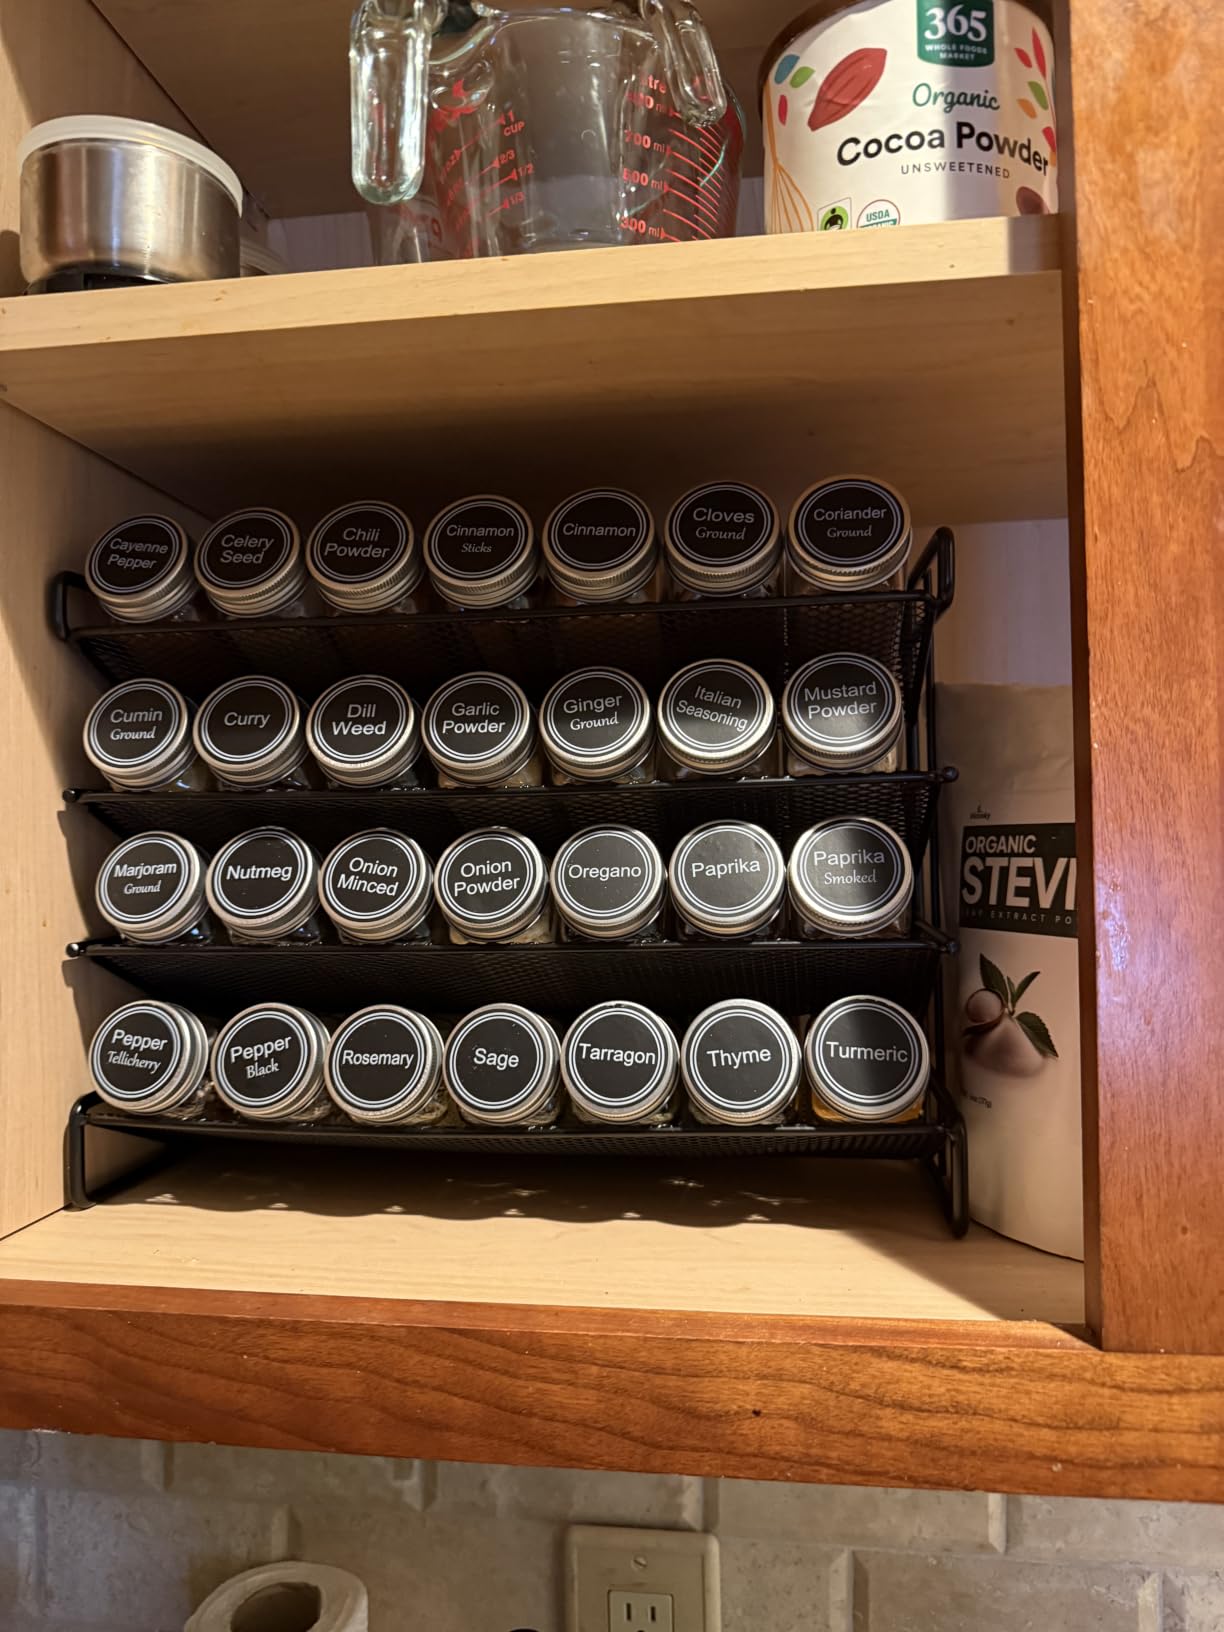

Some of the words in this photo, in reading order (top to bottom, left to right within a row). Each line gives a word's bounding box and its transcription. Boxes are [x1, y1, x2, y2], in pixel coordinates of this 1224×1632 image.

[924, 5, 987, 41] 365
[940, 52, 975, 60] MARKET
[960, 45, 987, 53] FOODS
[912, 83, 1000, 113] Organic
[503, 121, 525, 136] CUP
[837, 129, 945, 166] Cocoa
[956, 122, 1048, 176] Powder
[901, 162, 1010, 179] UNSWEETENED
[866, 209, 890, 222] USDA
[693, 506, 755, 524] Cloves
[813, 507, 888, 521] Coriander
[342, 527, 381, 541] Chili
[446, 524, 514, 538] Cinnamon
[562, 523, 636, 537] Cinnamon
[695, 526, 746, 540] Ground
[827, 525, 873, 538] Ground
[110, 538, 168, 554] Cayenne
[221, 534, 274, 550] Celery
[324, 543, 390, 558] Powder
[461, 543, 493, 554] Sticks
[107, 554, 156, 569] Pepper
[220, 550, 264, 564] Seed
[695, 685, 742, 709] Italian
[804, 681, 878, 701] Mustard
[347, 704, 376, 718] Dill
[451, 702, 500, 717] Garlic
[563, 693, 623, 715] Ginger
[807, 701, 878, 720] Powder
[110, 708, 163, 724] Cumin
[223, 712, 271, 729] Curry
[570, 713, 620, 731] Ground
[676, 700, 749, 732] Seasoning
[110, 727, 156, 740] Ground
[331, 720, 386, 735] Weed
[442, 719, 506, 734] Powder
[965, 834, 1037, 854] ORGANIC
[349, 857, 398, 877] Onion
[460, 859, 512, 876] Onion
[813, 850, 886, 868] Paprika
[113, 862, 177, 878] Marjoram
[226, 864, 293, 881] Nutmeg
[568, 863, 643, 882] Oregano
[691, 857, 761, 879] Paprika
[337, 873, 399, 897] Minced
[453, 875, 521, 897] Powder
[823, 870, 877, 886] Smoked
[124, 880, 162, 895] Ground
[990, 910, 1046, 923] EXTRACT
[111, 1029, 168, 1051] Pepper
[230, 1034, 292, 1063] Pepper
[342, 1050, 415, 1069] Rosemary
[473, 1047, 519, 1071] Sage
[578, 1043, 656, 1068] Tarragon
[706, 1047, 772, 1070] Thyme
[825, 1041, 909, 1063] Turmeric
[107, 1051, 161, 1074] Tellicherry
[246, 1059, 279, 1079] Black
